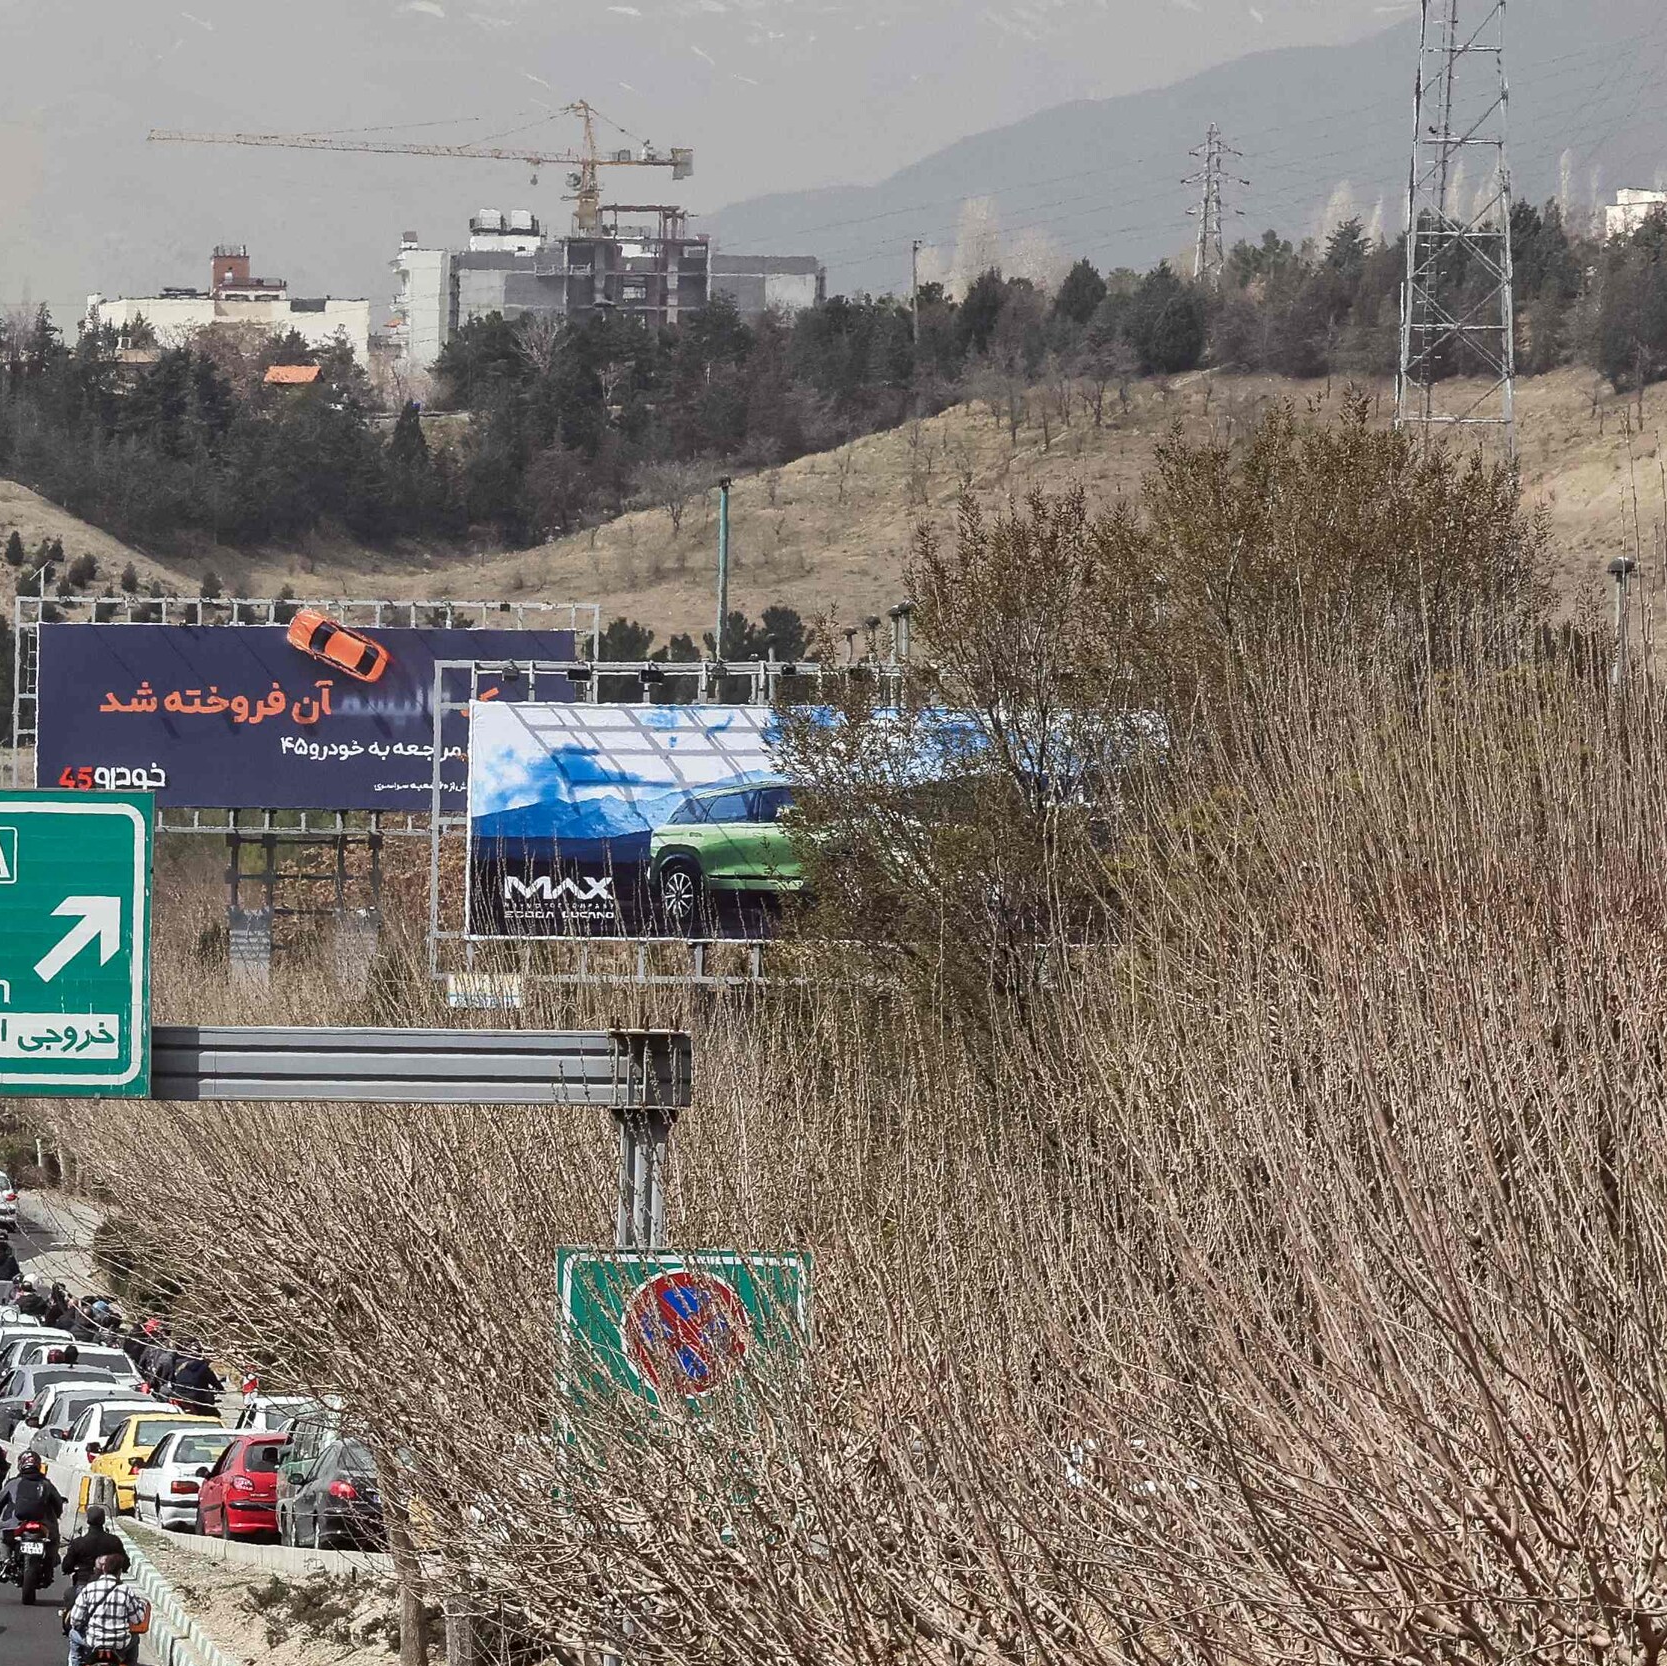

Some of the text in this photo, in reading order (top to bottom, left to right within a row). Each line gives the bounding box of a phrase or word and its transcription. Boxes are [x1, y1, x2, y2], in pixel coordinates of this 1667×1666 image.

[99, 683, 161, 714] شد
[165, 681, 286, 725] فروخته
[291, 680, 333, 724] آن
[368, 741, 389, 760] به
[18, 1015, 117, 1047] خروجی
